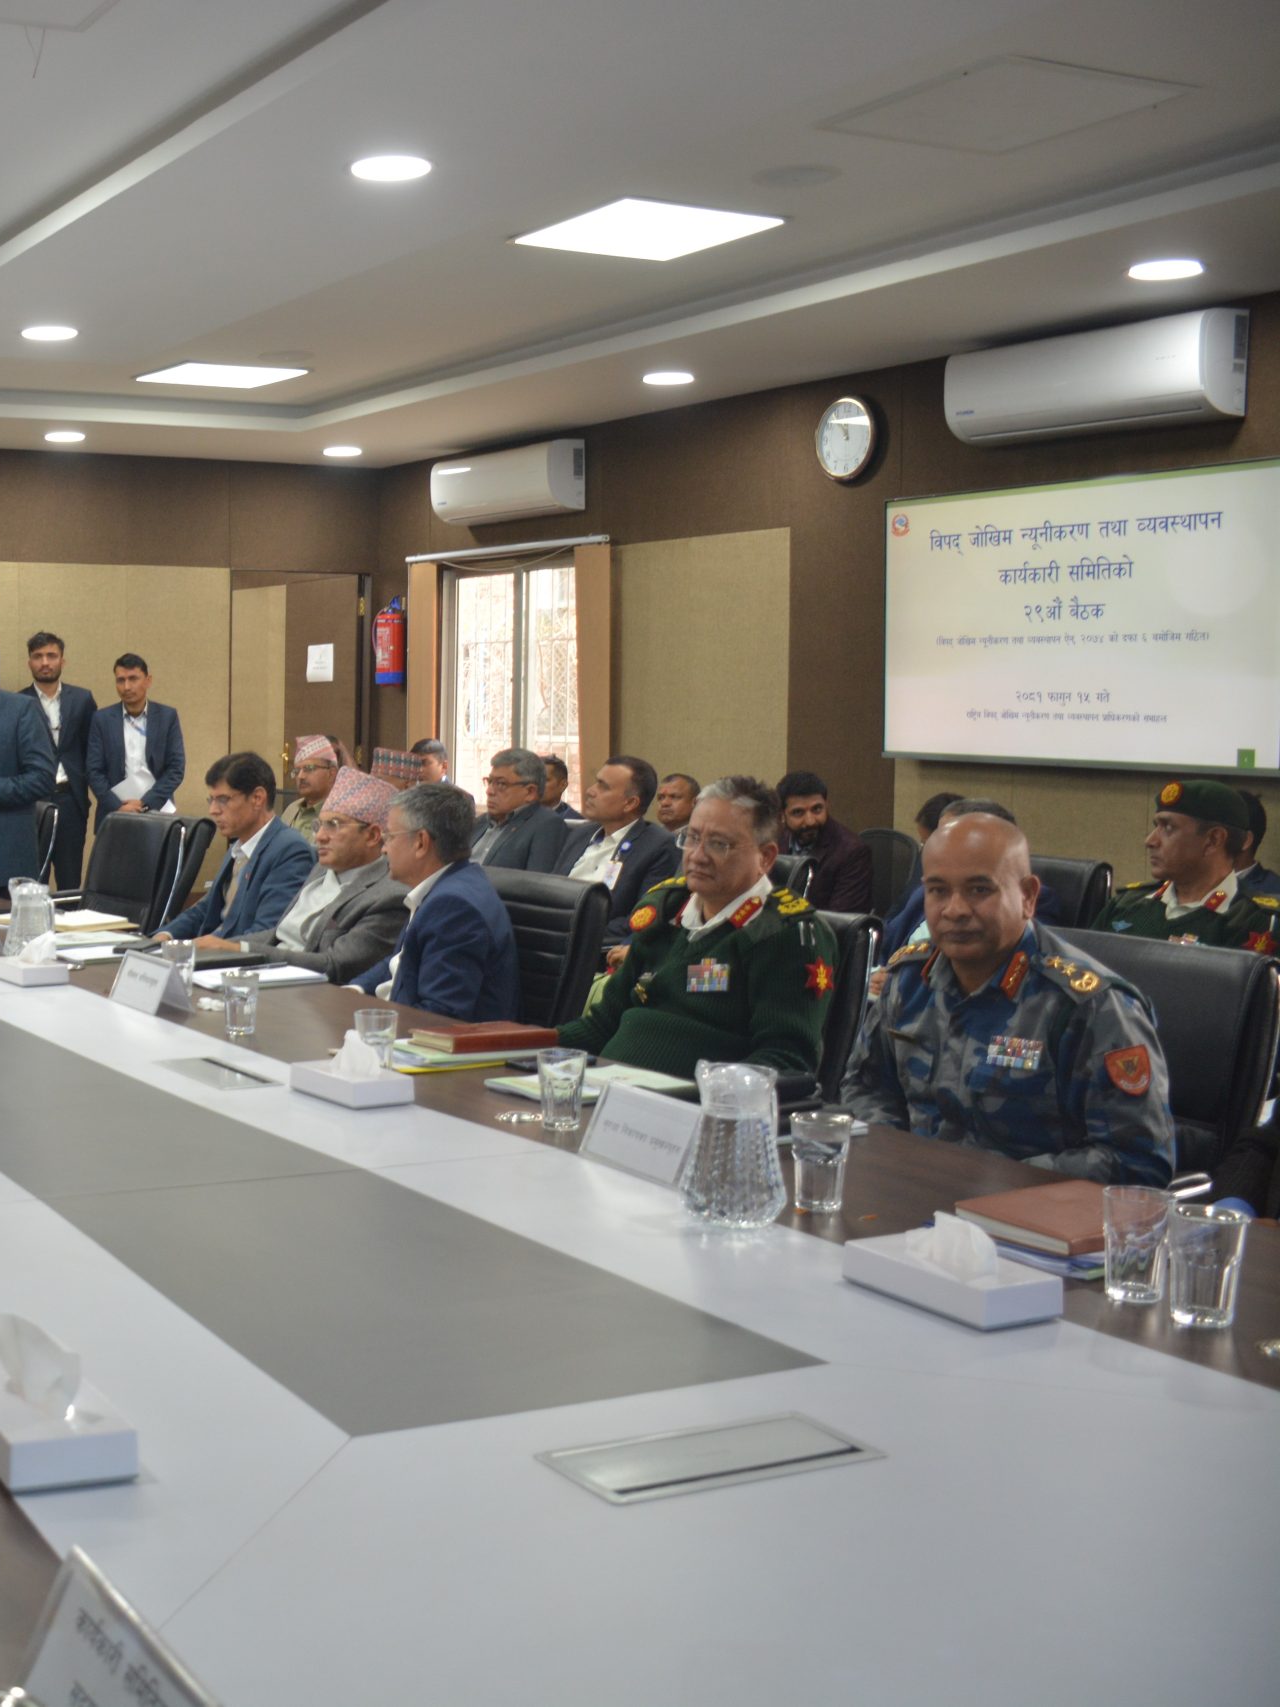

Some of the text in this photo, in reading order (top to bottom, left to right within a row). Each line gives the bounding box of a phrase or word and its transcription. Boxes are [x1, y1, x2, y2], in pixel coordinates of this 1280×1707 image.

[929, 511, 1223, 555] विपद् जोखिम न्यूनीकरण तथा व्यवस्थापन
[998, 554, 1134, 585] कार्यकारी समितिको
[1068, 595, 1106, 621] बैठक
[1048, 690, 1071, 707] फागुन
[1096, 688, 1110, 703] गते
